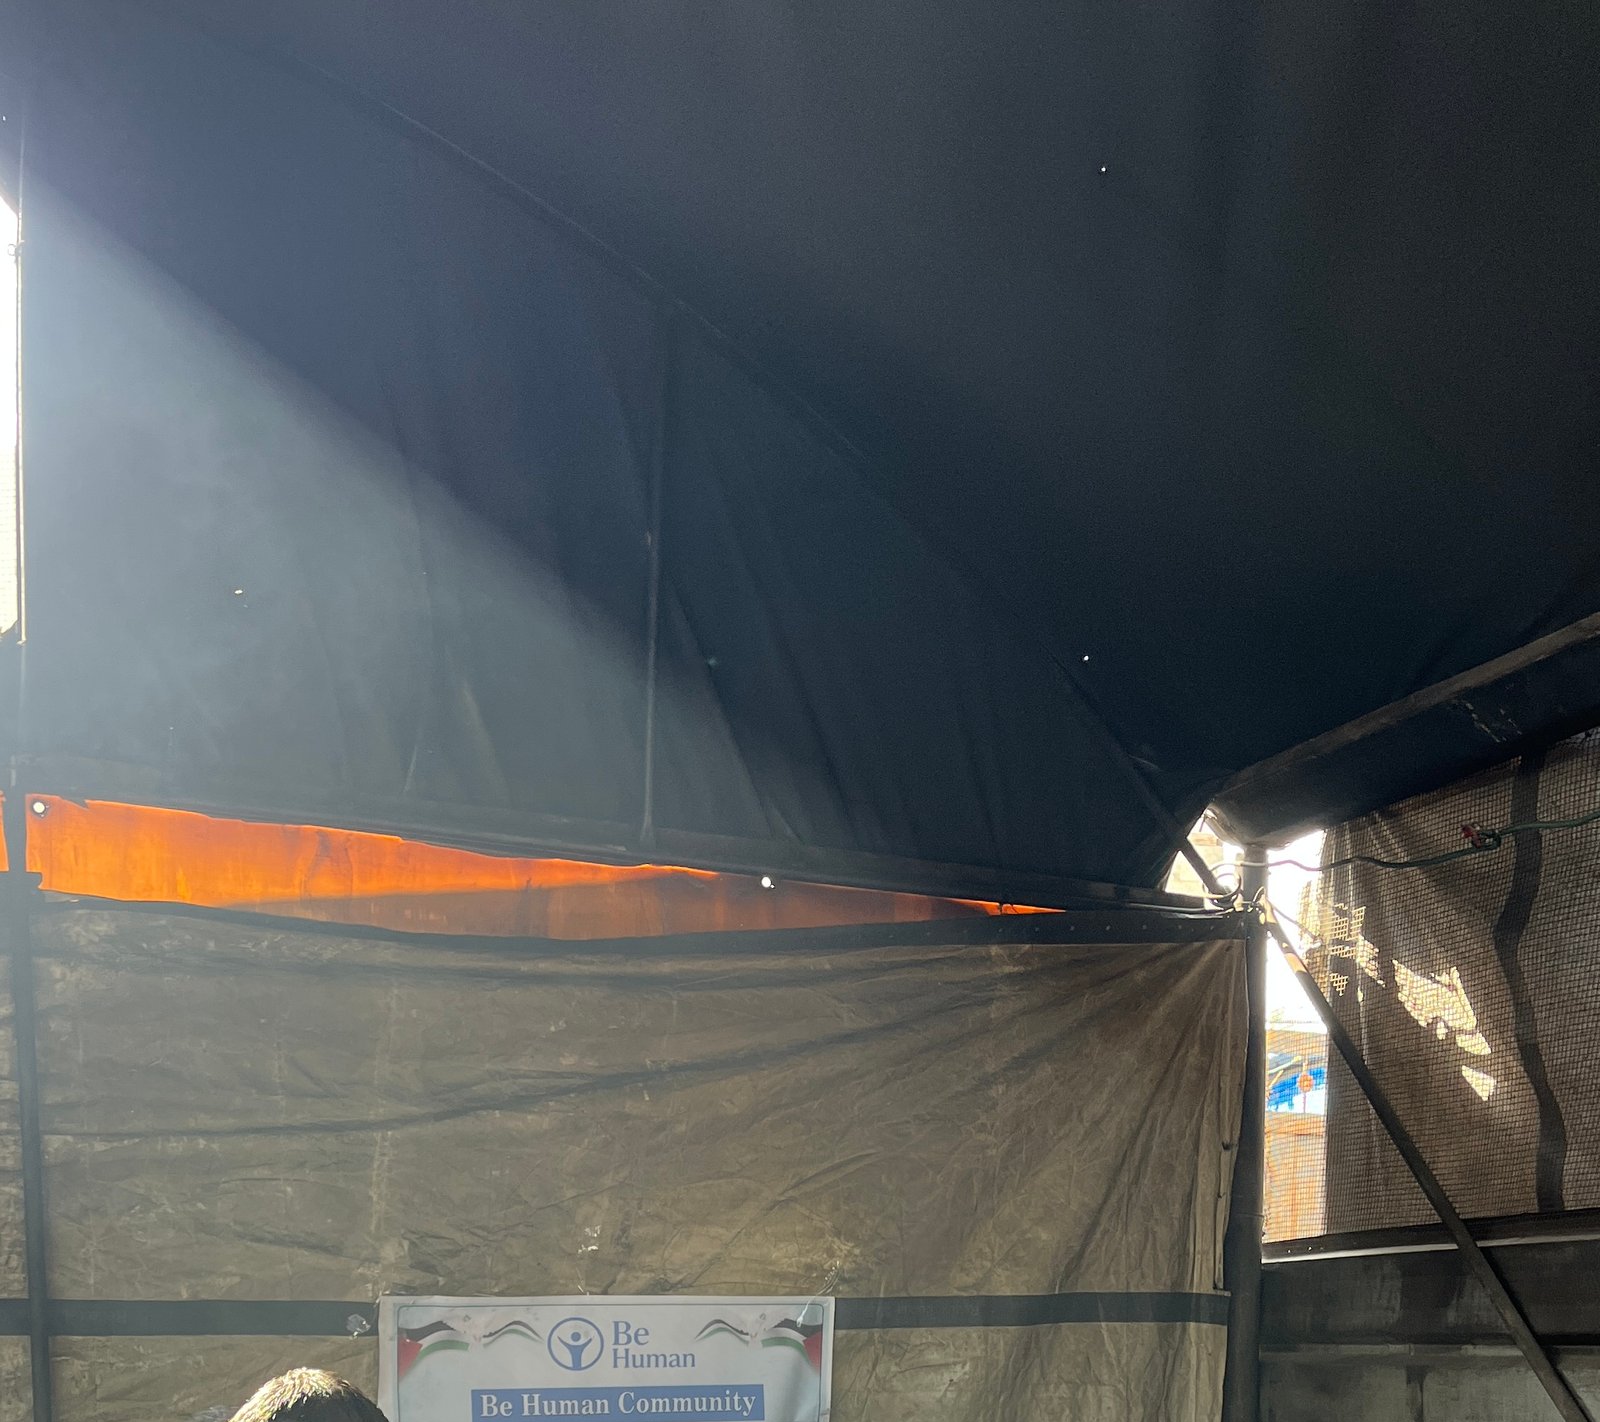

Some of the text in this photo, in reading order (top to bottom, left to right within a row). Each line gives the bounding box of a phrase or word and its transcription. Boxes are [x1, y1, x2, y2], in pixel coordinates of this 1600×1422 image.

[612, 1320, 650, 1346] Be
[612, 1348, 696, 1369] Human
[480, 1389, 756, 1417] Be Human Community
